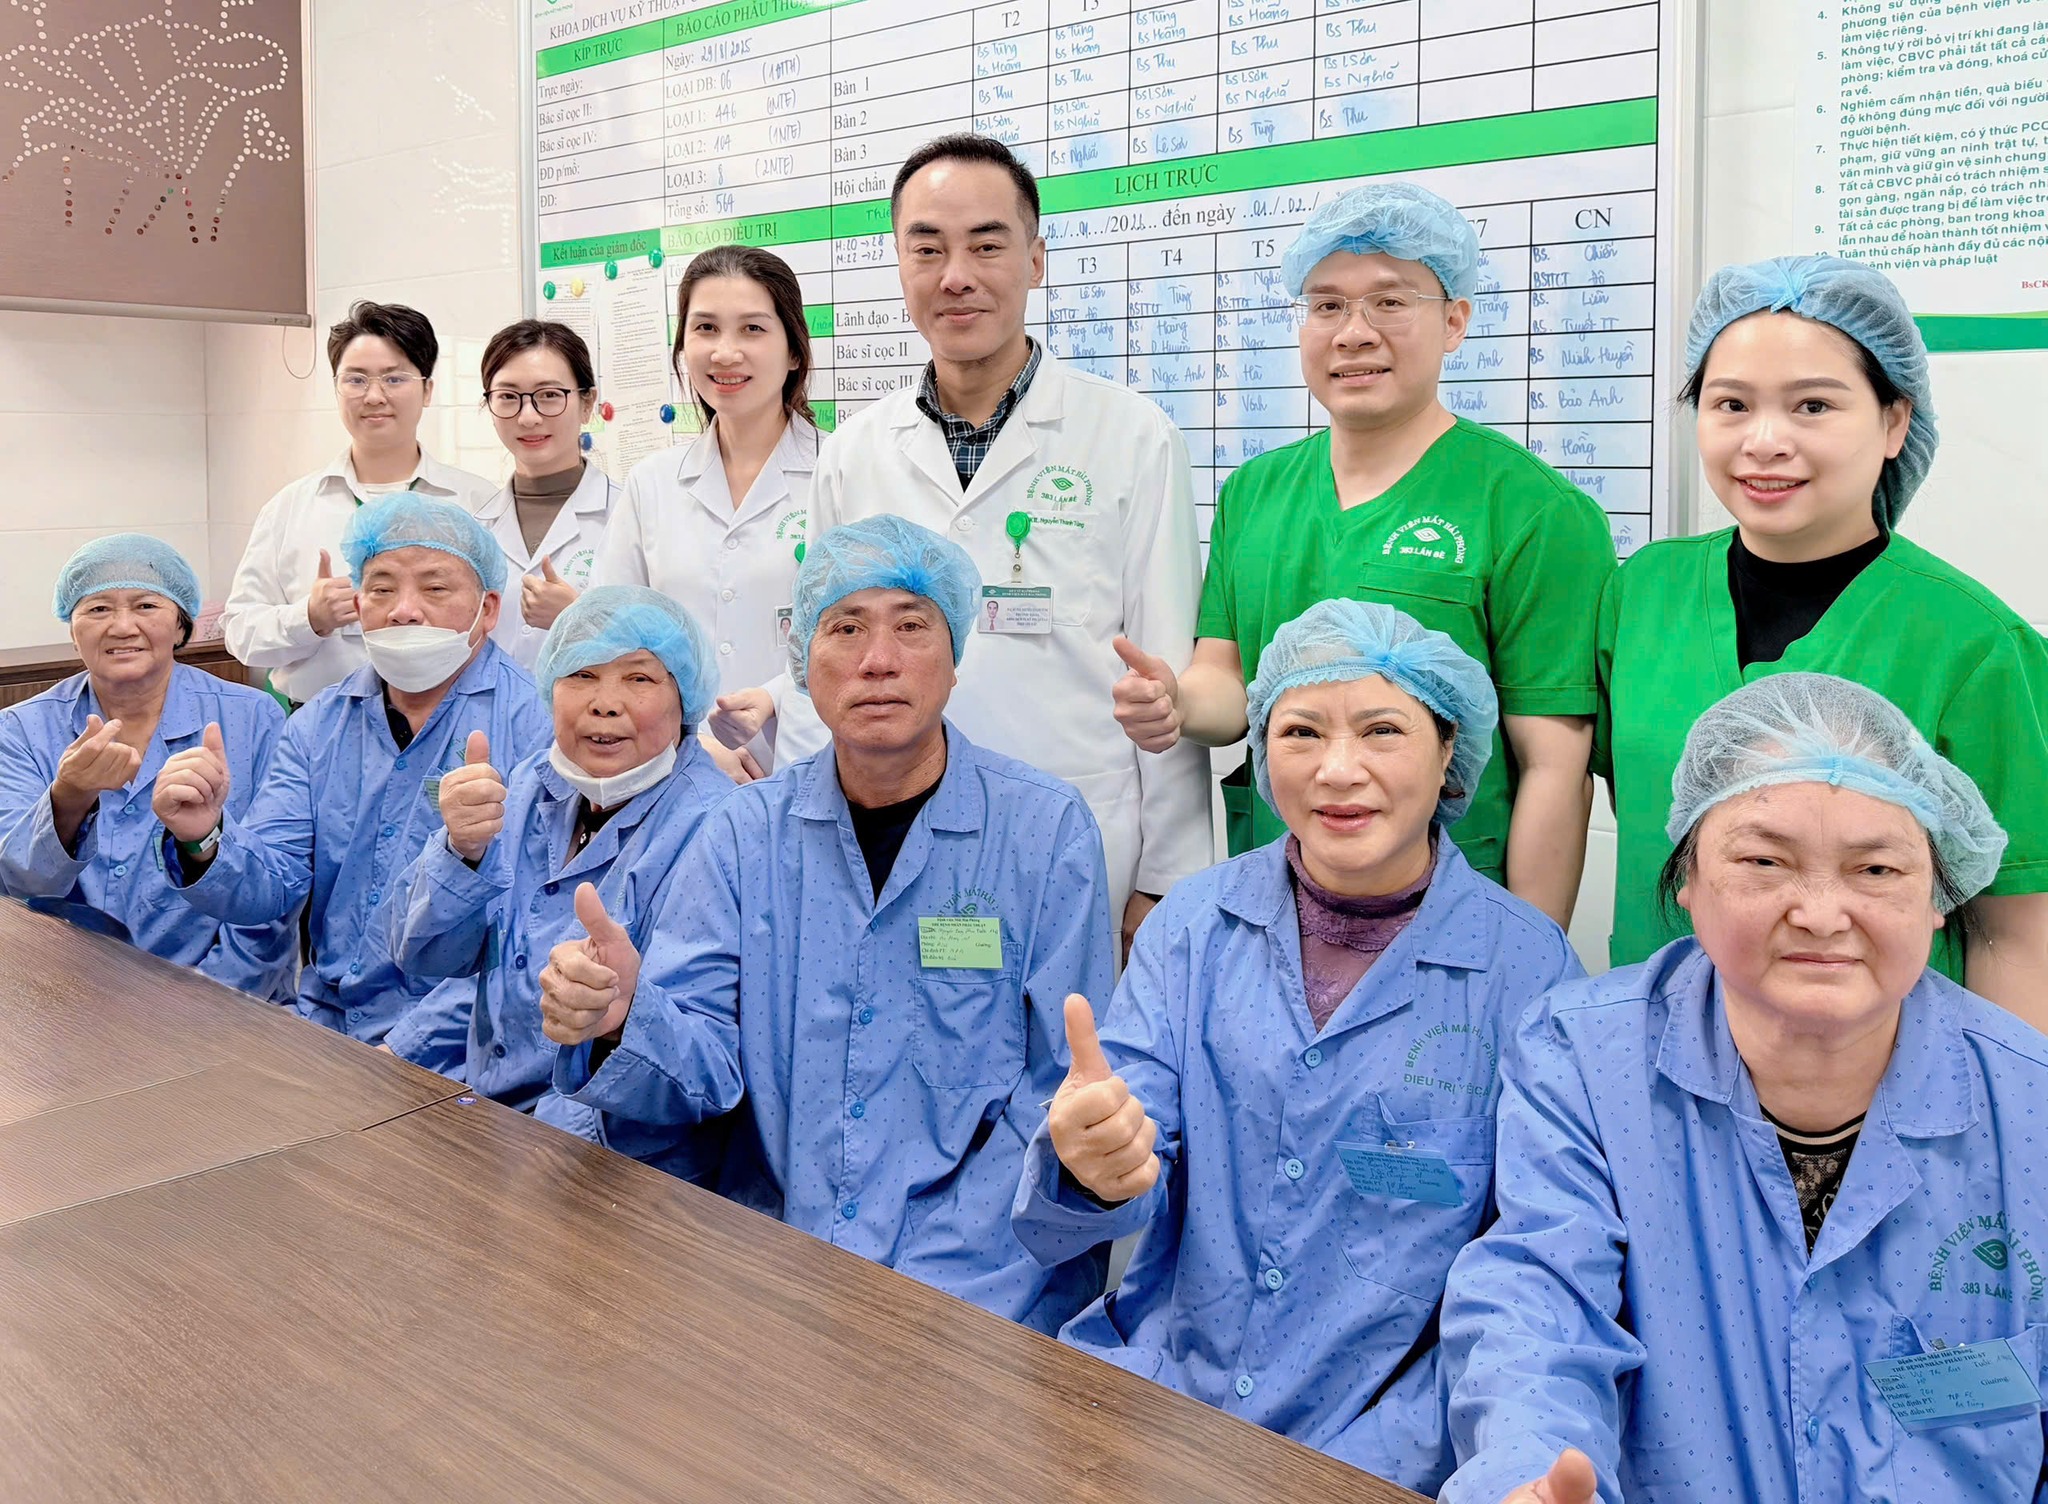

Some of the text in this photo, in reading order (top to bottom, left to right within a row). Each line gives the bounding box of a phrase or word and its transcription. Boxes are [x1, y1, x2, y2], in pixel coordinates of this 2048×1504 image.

[550, 22, 579, 40] KHOA
[582, 13, 608, 32] DỊCH
[610, 10, 626, 24] VỤ
[676, 16, 702, 37] BÁO
[704, 10, 731, 30] CÁO
[1002, 10, 1020, 28] T2
[1841, 2, 1978, 32] phương tiện của bệnh
[1817, 24, 2030, 60] 5. Không tự ý rời bỏ vị trí khi đang
[1841, 25, 1927, 43] làm việc riêng.
[573, 37, 623, 63] KÍP TRỰC
[666, 52, 694, 71] Ngày:
[539, 78, 583, 98] Trực ngày:
[666, 79, 693, 99] LOẠI
[834, 76, 869, 97] Bàn 1
[539, 102, 592, 126] Bác sĩ cọc II:
[666, 111, 696, 129] LOẠI
[834, 110, 867, 130] Bàn 2
[1816, 124, 2018, 154] 7. Thực hiện tiết kiệm, có ý thức
[1840, 123, 1911, 139] người bệnh.
[539, 130, 597, 153] Bác sĩ cọc IV:
[667, 141, 696, 159] LOẠI
[697, 140, 706, 153] 2:
[834, 144, 867, 163] Bàn 3
[540, 166, 554, 180] ĐD
[1839, 168, 1860, 178] văn
[1863, 165, 1893, 176] minh
[1896, 163, 1910, 173] và
[1934, 159, 1954, 172] gìn
[1957, 157, 1972, 168] vệ
[1974, 155, 2002, 165] sinh
[2005, 151, 2046, 163] chung
[667, 172, 694, 189] LOẠI
[697, 170, 706, 184] 3:
[834, 171, 886, 198] Hội chẩn
[1114, 165, 1219, 194] LỊCH TRỰC
[1815, 166, 2040, 194] 8. Tất cả CBVC phải có trách nhiệm
[540, 194, 558, 208] ĐD:
[667, 200, 692, 219] Tổng
[694, 196, 709, 214] số:
[1162, 202, 1236, 227] đến ngày
[1574, 207, 1612, 230] CN
[668, 230, 693, 248] BÁO
[694, 226, 721, 246] CÁO
[756, 224, 778, 240] TRỊ
[553, 234, 647, 261] Kết luận của giám đốc
[1161, 249, 1183, 266] T4
[1252, 240, 1274, 258] T5
[1078, 257, 1097, 274] T3
[1894, 254, 1998, 269] viện và pháp luật
[836, 307, 889, 328] Lãnh đạo
[836, 342, 908, 360] Bác sĩ cọc II
[837, 376, 858, 392] Bác
[862, 376, 872, 390] sĩ
[875, 377, 895, 393] cọc
[1928, 1218, 1975, 1292] BỆNH VIỆN
[1963, 1282, 1981, 1294] 383
